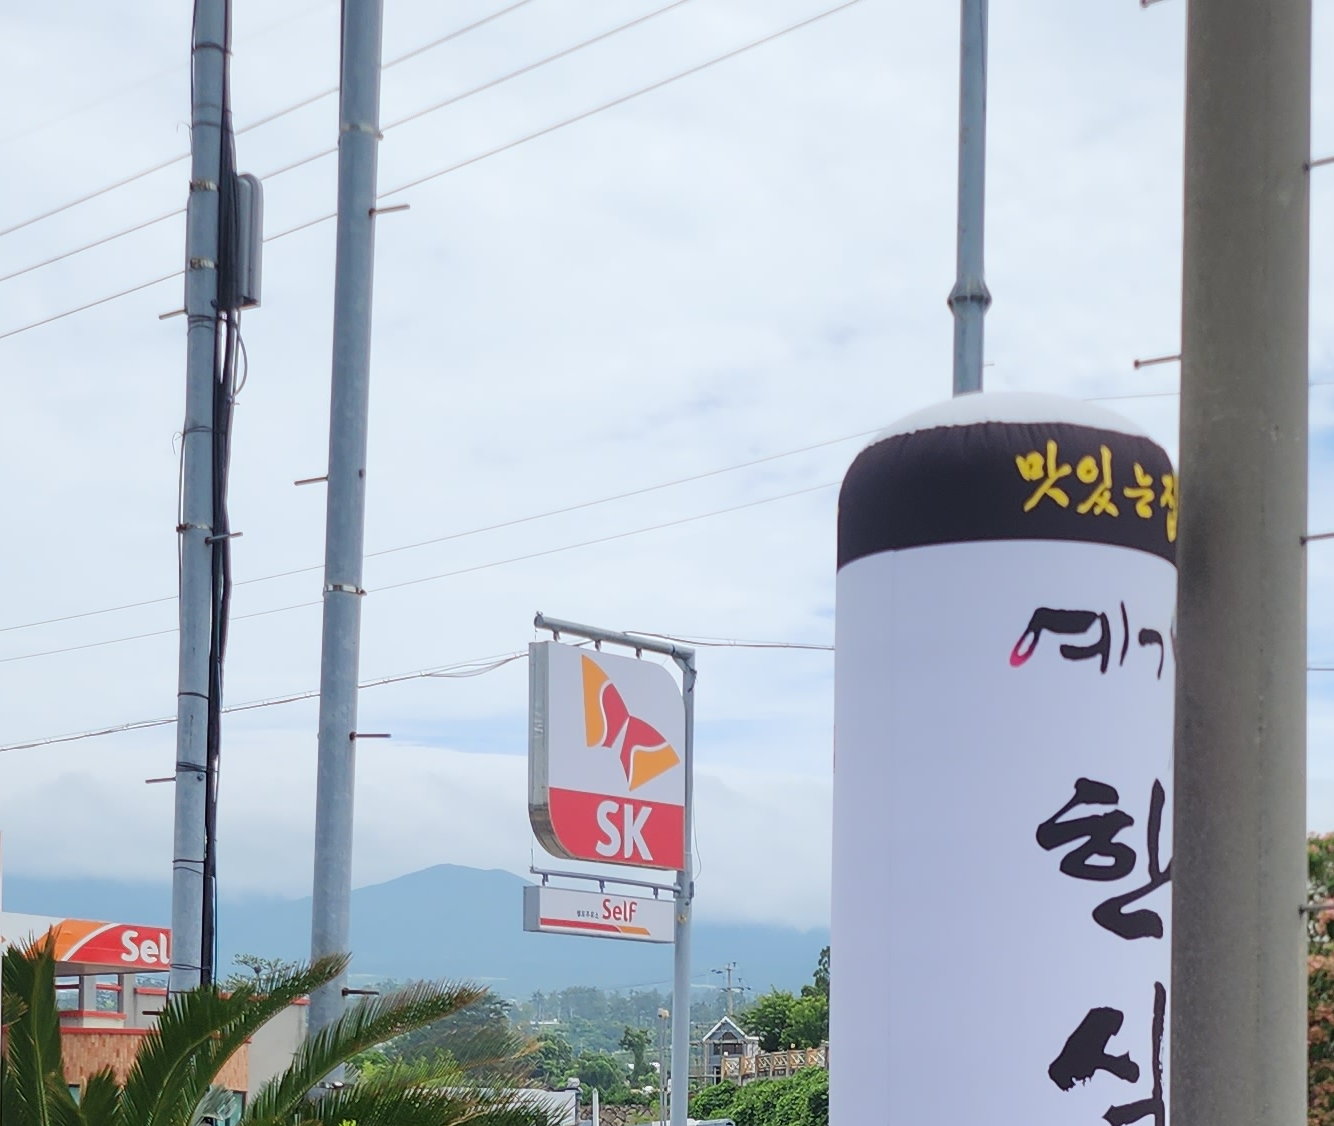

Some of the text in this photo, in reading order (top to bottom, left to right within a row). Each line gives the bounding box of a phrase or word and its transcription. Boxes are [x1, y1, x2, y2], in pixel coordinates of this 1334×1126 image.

[595, 799, 654, 862] SK
[602, 898, 638, 923] Self
[121, 929, 171, 965] Sel
